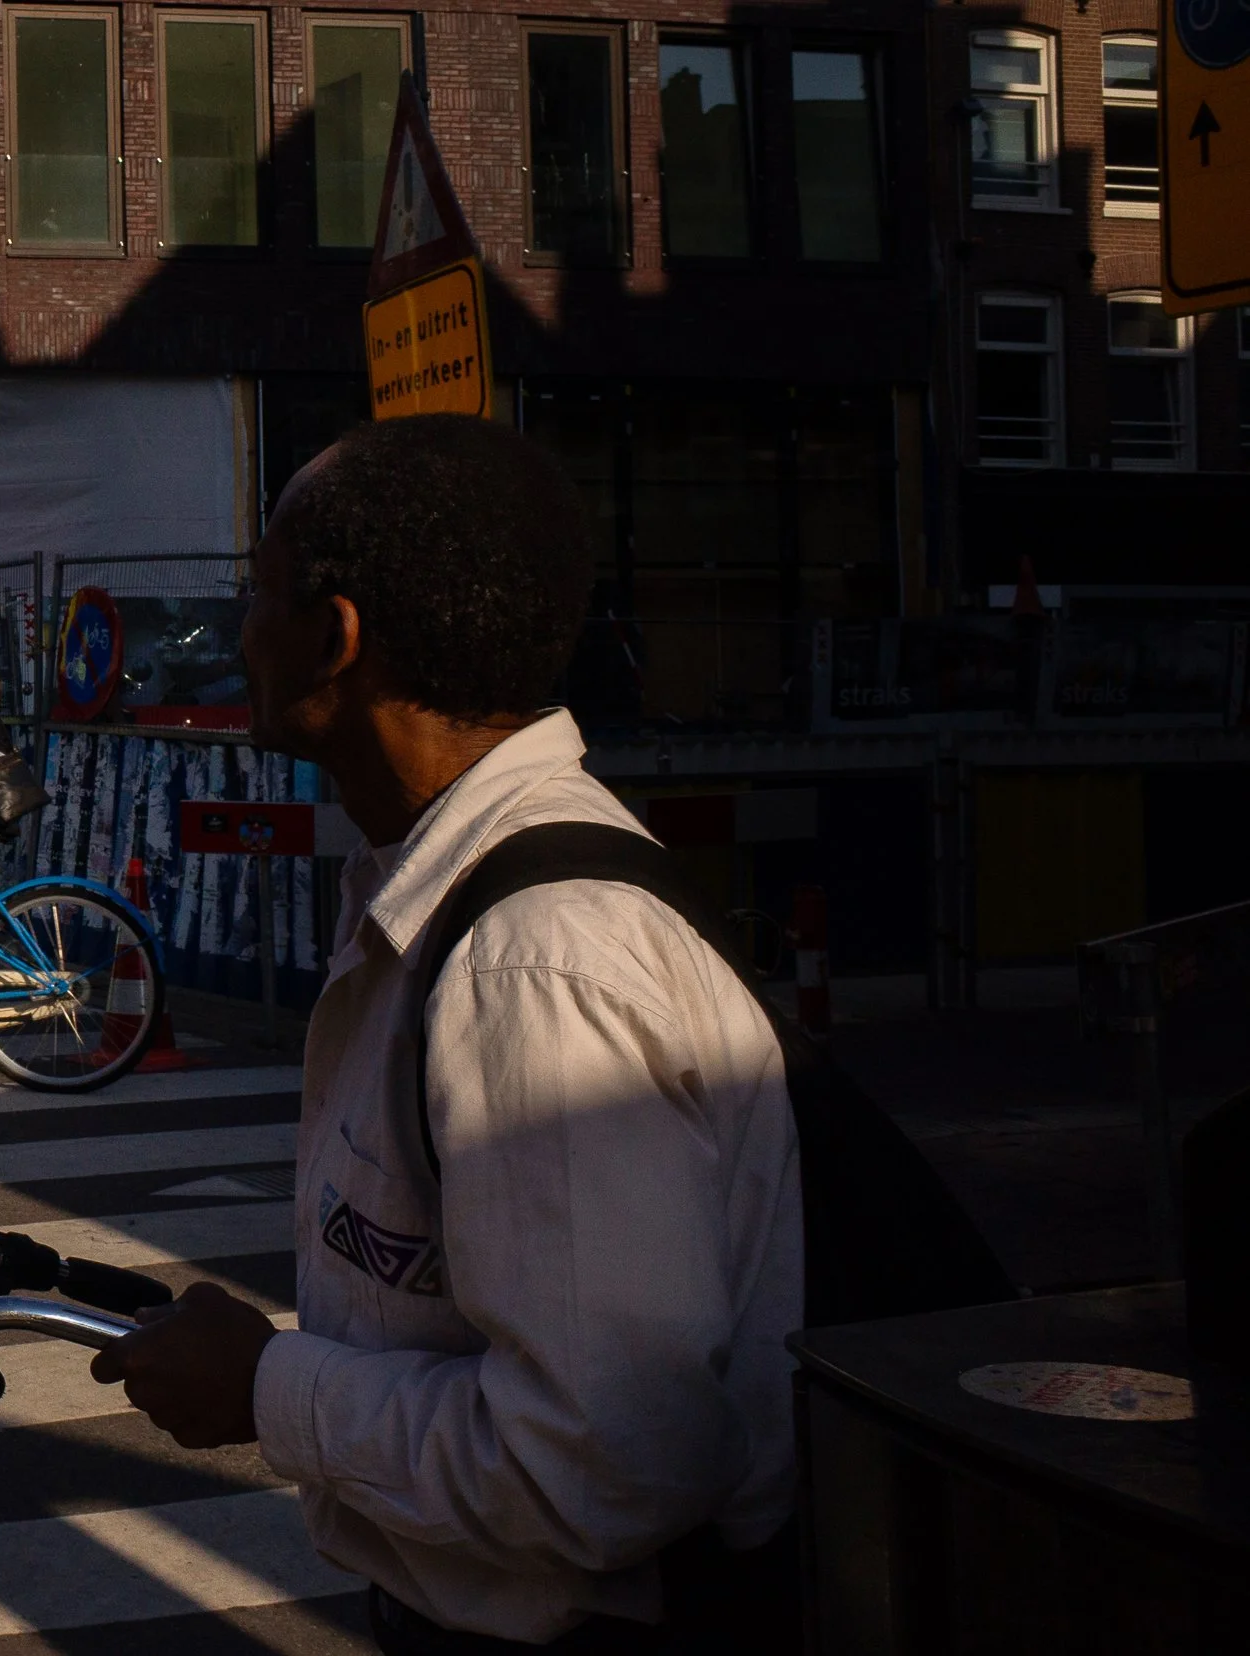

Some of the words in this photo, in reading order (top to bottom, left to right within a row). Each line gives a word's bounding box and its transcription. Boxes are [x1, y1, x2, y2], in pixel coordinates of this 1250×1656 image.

[396, 326, 412, 350] en
[417, 301, 468, 340] uitrit
[375, 355, 475, 404] werkverkeer
[838, 677, 913, 707] straks
[1060, 678, 1129, 706] straks
